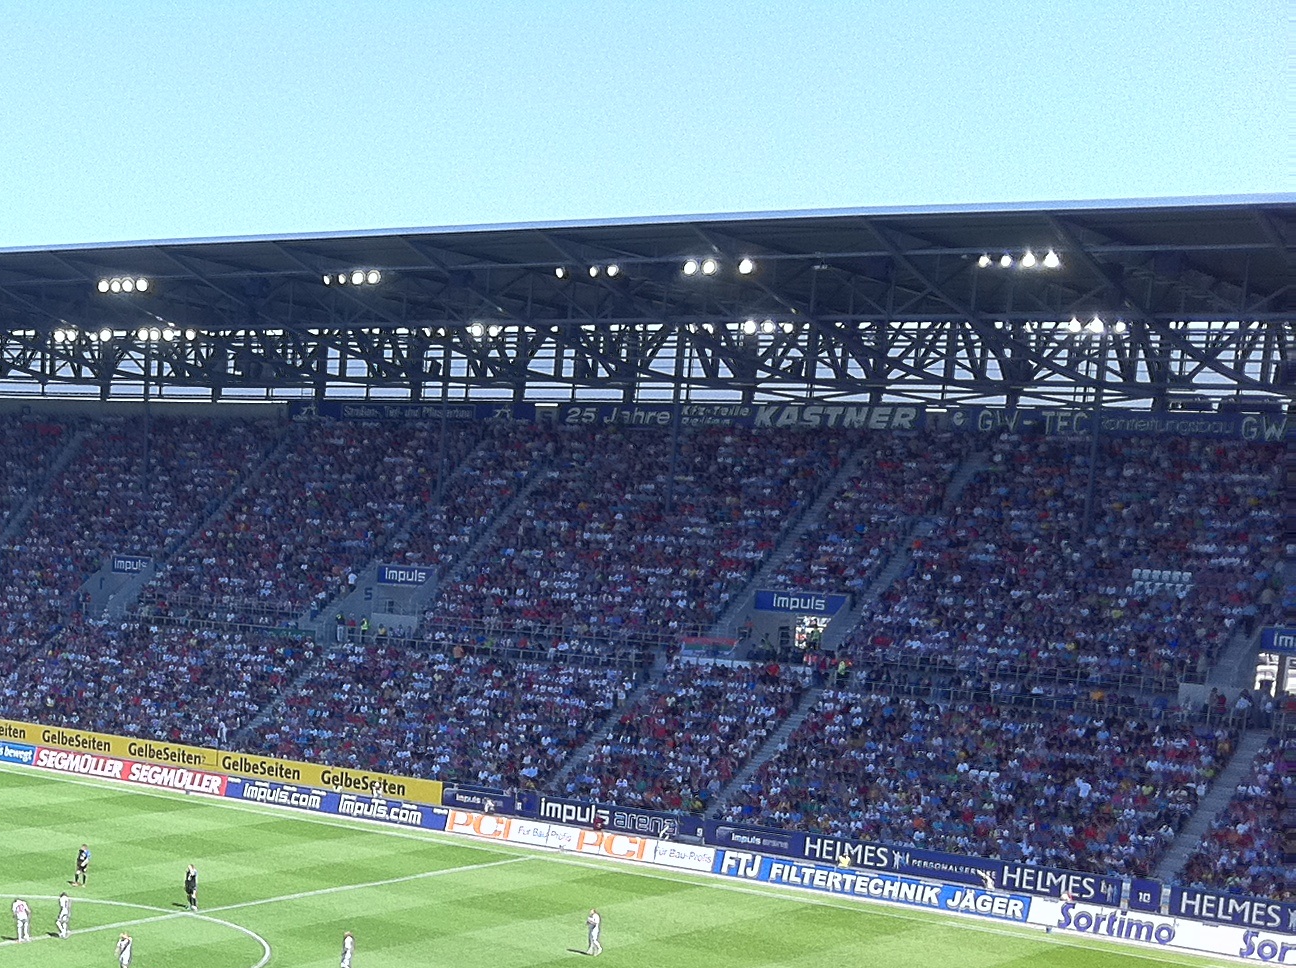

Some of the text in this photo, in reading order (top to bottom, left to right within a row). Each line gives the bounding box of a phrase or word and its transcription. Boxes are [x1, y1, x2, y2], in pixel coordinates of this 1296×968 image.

[565, 407, 671, 425] 25 Jahre
[754, 405, 917, 429] KASTNER
[385, 566, 426, 583] impuls
[772, 593, 826, 611] impuls
[3, 745, 33, 763] bewegt
[42, 729, 111, 752] GelbeSeiten
[128, 742, 202, 765] GelbeSeiten
[222, 756, 301, 780] GelbeSeiten
[321, 769, 406, 796] GelbeSeiten
[36, 748, 223, 795] SEGMÜLLER SEGMÜLLER
[243, 783, 422, 825] impuls.com impuls.com
[540, 797, 610, 825] impuls
[613, 812, 678, 836] arena
[447, 810, 512, 840] PCI
[576, 828, 647, 860] PCI
[696, 827, 703, 837] 9
[732, 832, 761, 845] impuls
[804, 836, 888, 867] HELMES
[720, 850, 1025, 921] FTJ FILTERTECHNIK JÄGER
[1002, 865, 1096, 899] HELMES
[1138, 891, 1152, 904] 10
[1057, 901, 1176, 945] Sortimo
[1180, 891, 1282, 928] HELMES
